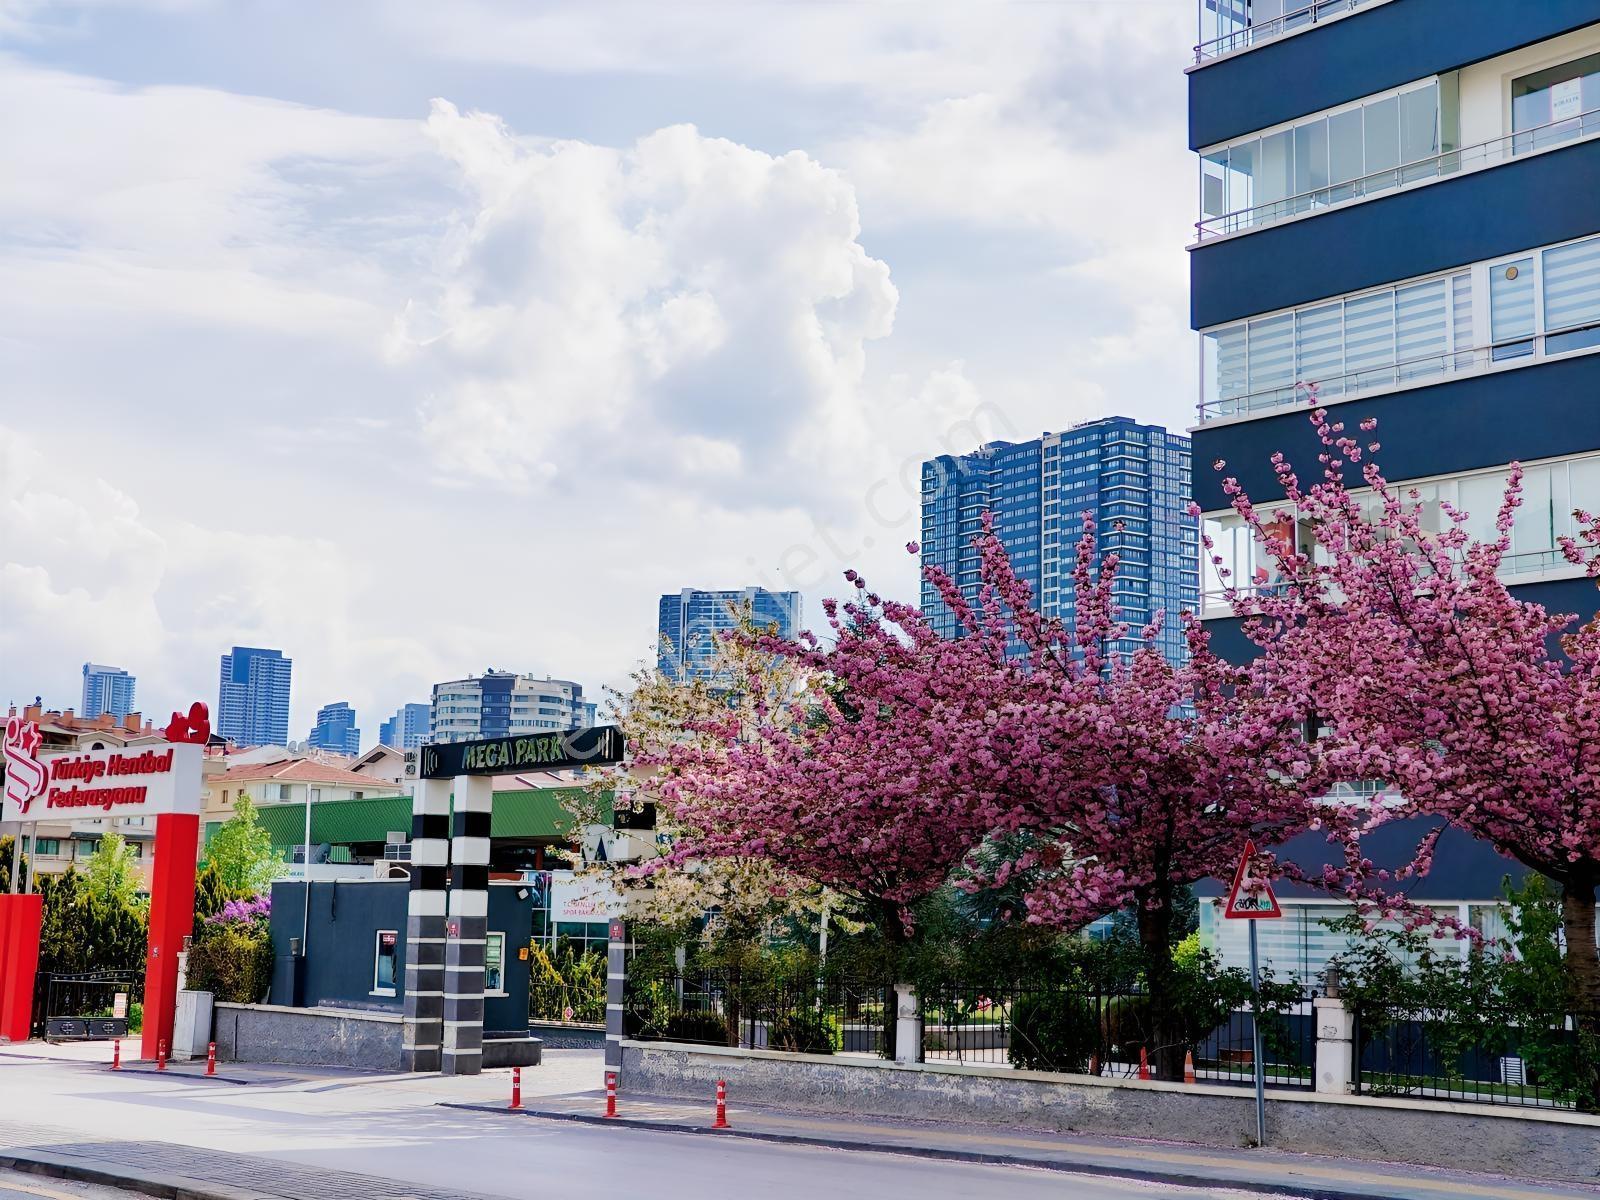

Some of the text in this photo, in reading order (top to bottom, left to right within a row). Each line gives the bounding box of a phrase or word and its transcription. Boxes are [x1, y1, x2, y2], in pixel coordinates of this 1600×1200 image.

[51, 748, 174, 783] Türkiye Hentbol
[462, 736, 567, 769] MEGA PARK
[47, 785, 148, 810] Federasyonu
